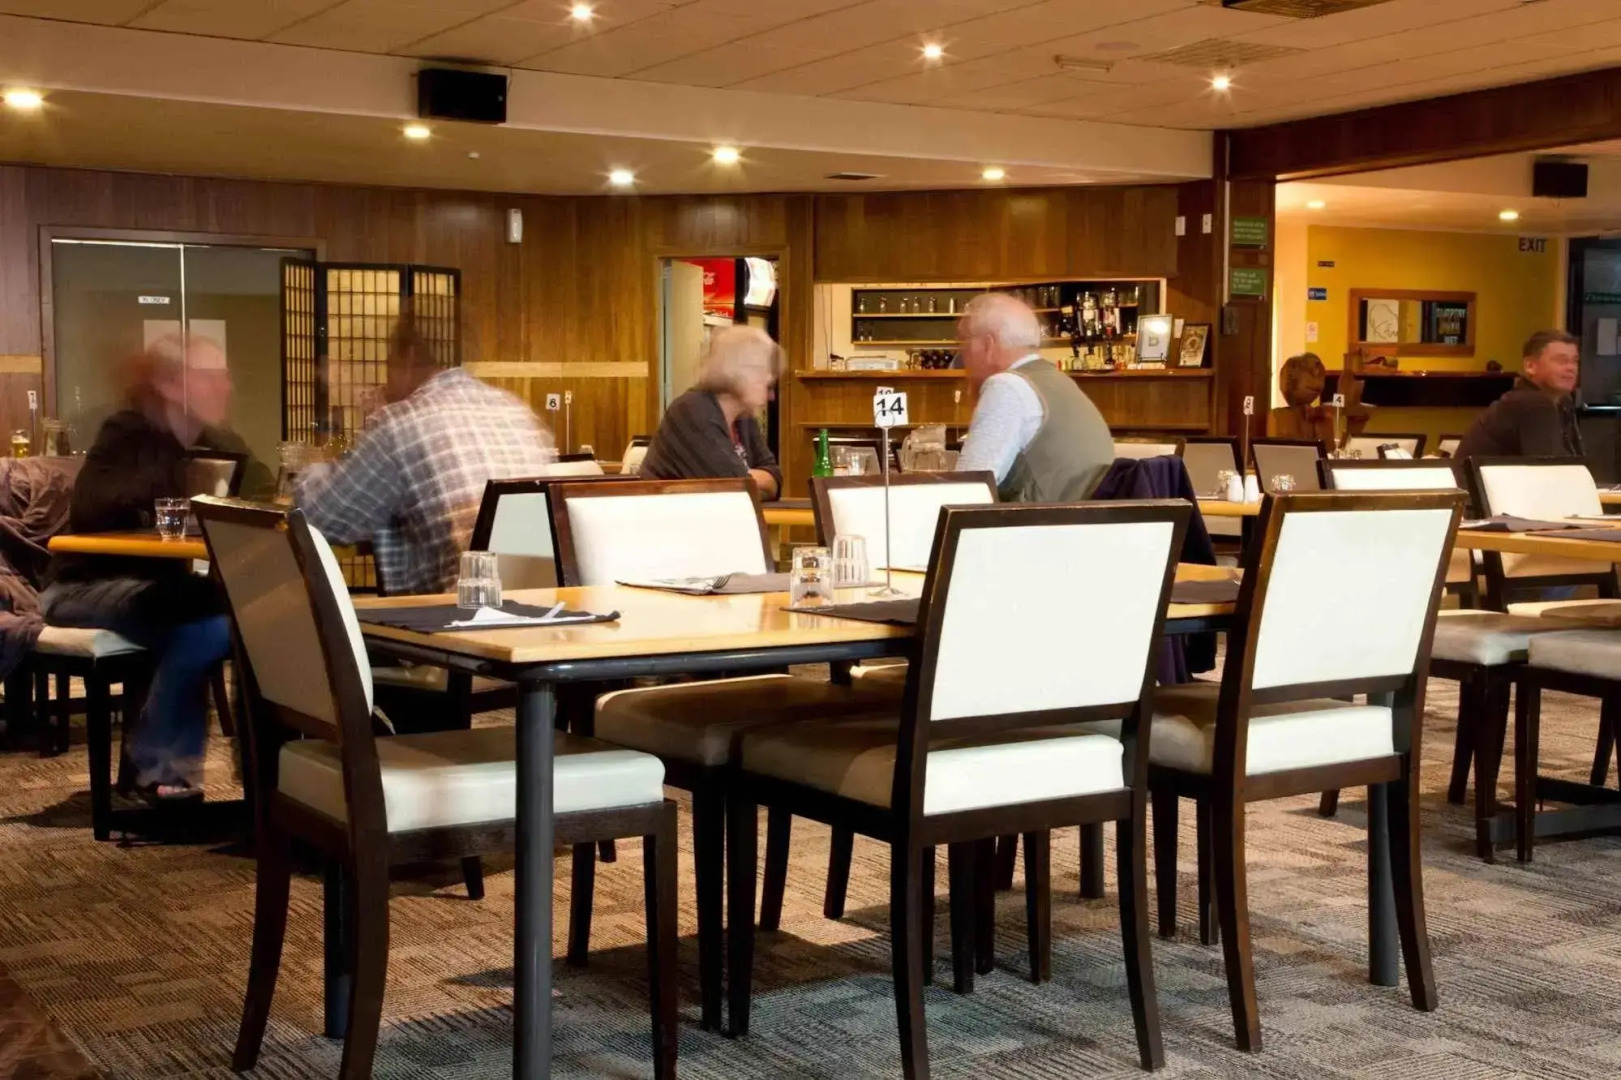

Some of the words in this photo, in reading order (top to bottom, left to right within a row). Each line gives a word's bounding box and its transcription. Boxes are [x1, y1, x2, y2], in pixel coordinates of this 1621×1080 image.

[1519, 237, 1547, 253] EXIT
[549, 398, 557, 408] 6
[876, 396, 905, 417] 14
